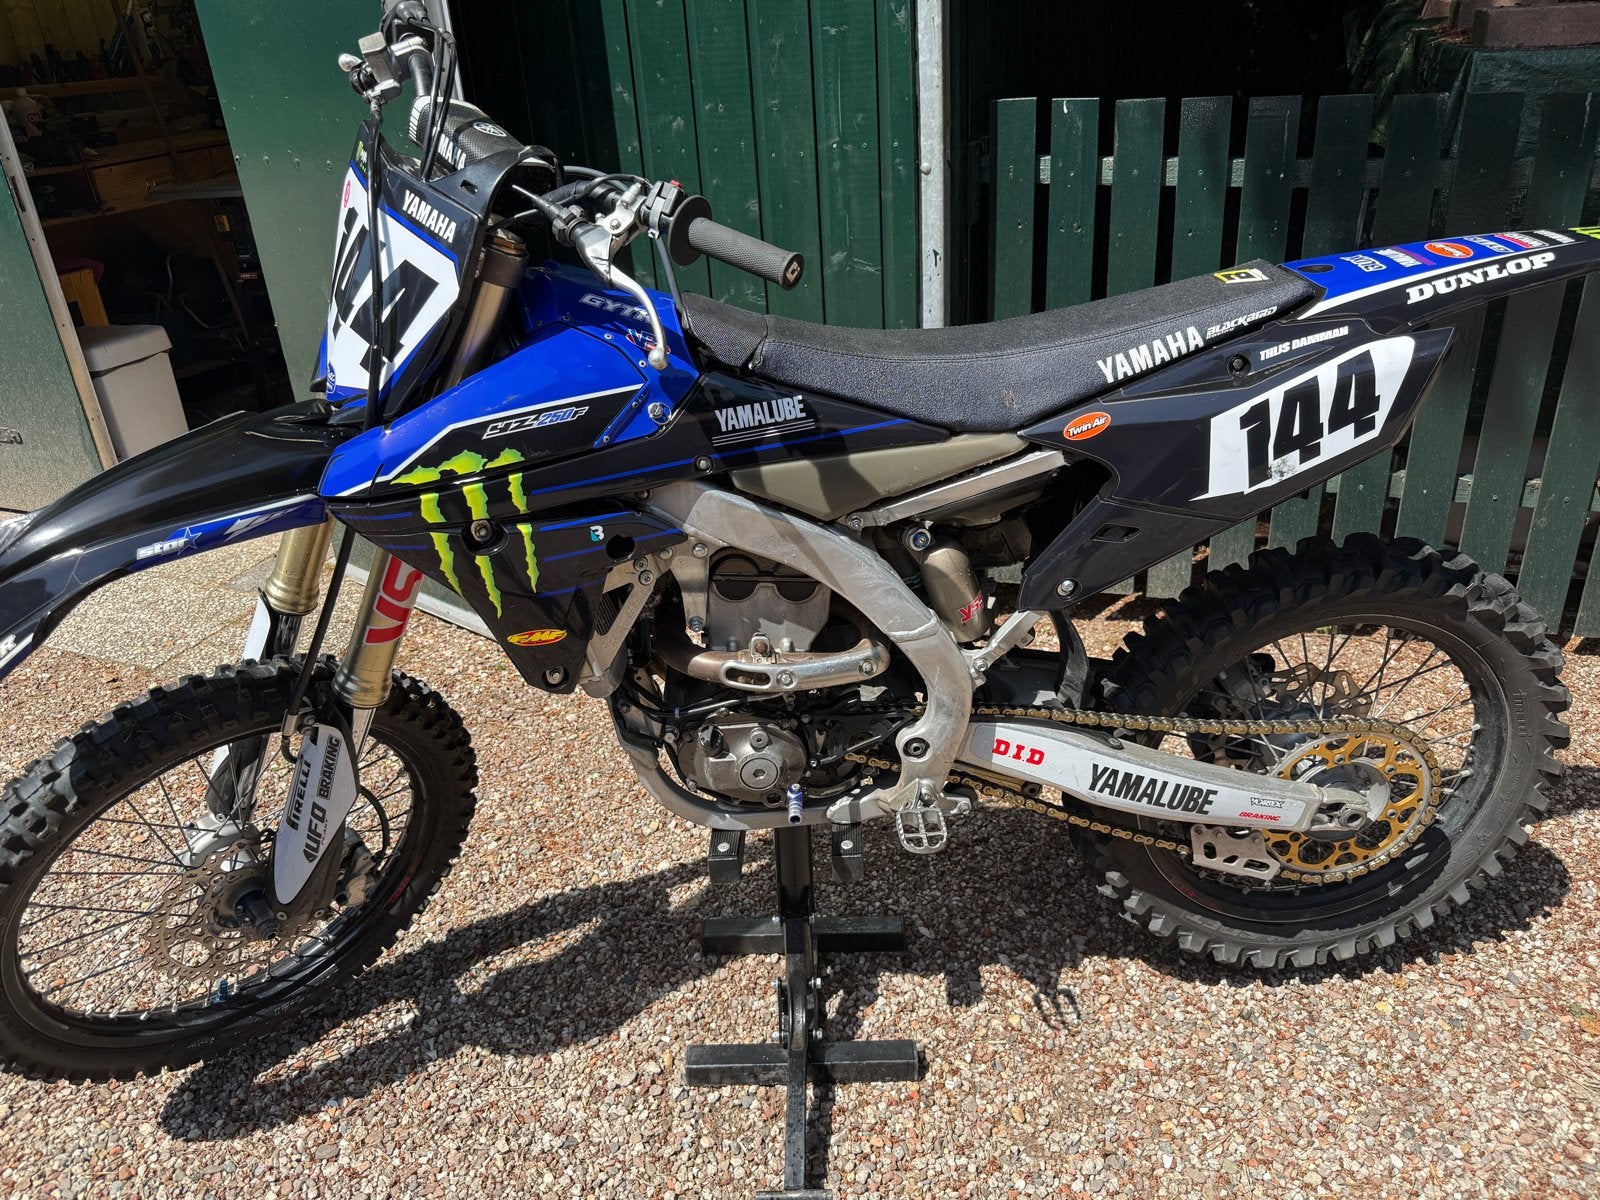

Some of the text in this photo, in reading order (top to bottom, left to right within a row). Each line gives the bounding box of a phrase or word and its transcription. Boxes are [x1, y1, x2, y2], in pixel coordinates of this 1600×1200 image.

[402, 189, 457, 243] YAMAHA
[1406, 252, 1556, 304] DUNLOP
[1096, 326, 1205, 384] YAMAHA
[714, 395, 805, 432] YAMALUBE
[1067, 416, 1107, 437] Twin Air
[1240, 349, 1381, 490] 144
[507, 629, 568, 644] FMF
[286, 754, 312, 831] PIRELLI
[318, 735, 341, 800] BRAKING
[1088, 764, 1219, 816] YAMALUBE
[304, 801, 327, 856] UFO
[1239, 811, 1282, 822] BRAKING
